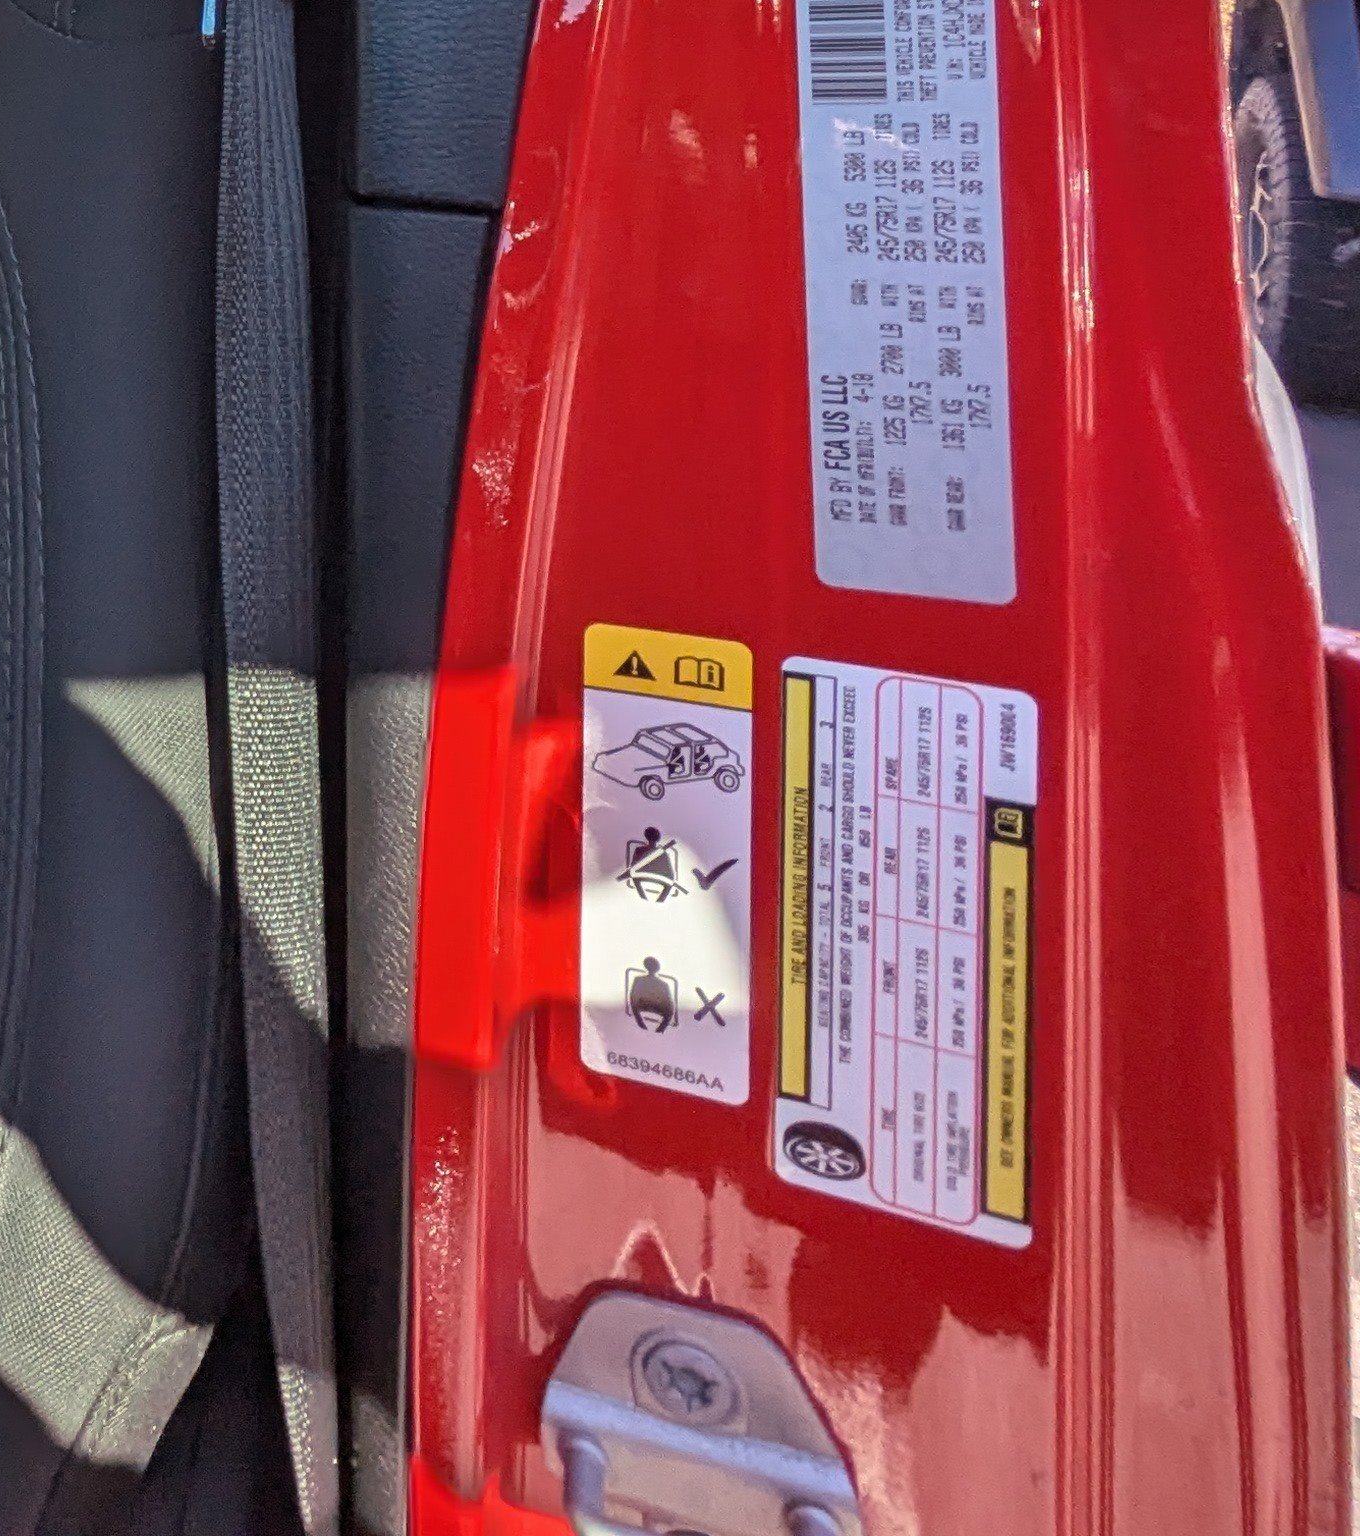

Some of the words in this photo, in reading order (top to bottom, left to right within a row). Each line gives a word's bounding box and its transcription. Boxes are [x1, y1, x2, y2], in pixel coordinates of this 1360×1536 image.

[917, 14, 936, 70] PREVENTION
[894, 37, 913, 76] VEHICLE
[968, 40, 986, 79] VEHICLE
[896, 80, 914, 102] THIS
[919, 75, 937, 101] THEFT
[844, 130, 865, 146] LB
[932, 113, 952, 140] TIRES
[844, 153, 866, 182] 5300
[874, 159, 897, 188] 112S
[931, 160, 955, 188] 112S
[902, 178, 924, 194] 36
[960, 180, 984, 195] 36
[845, 202, 867, 217] KG
[845, 224, 868, 254] 2405
[874, 196, 900, 262] 245/75R17
[933, 196, 958, 264] 245/75R17
[904, 240, 927, 263] 250
[962, 241, 986, 264] 250
[908, 284, 925, 296] AT
[910, 301, 926, 322] RIMS
[880, 324, 902, 338] LB
[938, 326, 960, 342] LB
[881, 344, 904, 375] 2700
[939, 347, 962, 377] 3000
[820, 374, 848, 405] LLC
[852, 374, 874, 403] 4-18
[882, 396, 905, 411] KG
[940, 398, 964, 414] KG
[822, 411, 849, 433] US
[884, 416, 906, 446] 1225
[942, 423, 965, 450] 1361
[823, 440, 850, 471] FCA
[830, 478, 852, 492] BY
[857, 485, 875, 496] OF
[857, 502, 876, 524] DATE
[819, 720, 834, 729] 3
[842, 726, 855, 758] NEVER
[820, 762, 831, 786] REAR
[842, 762, 854, 803] SHOULD
[885, 757, 898, 790] SPARE
[818, 804, 833, 812] 2
[792, 786, 808, 870] INFORMATION
[842, 806, 854, 840] CARGO
[819, 836, 830, 867] FRONT
[841, 844, 853, 864] AND
[792, 873, 808, 926] LOADING
[817, 882, 832, 892] 5
[840, 868, 852, 928] OCCUPANTS
[792, 930, 806, 954] AND
[840, 932, 852, 944] OF
[791, 958, 806, 984] TIRE
[839, 1045, 852, 1064] THE
[607, 1051, 724, 1092] 68394686AA
